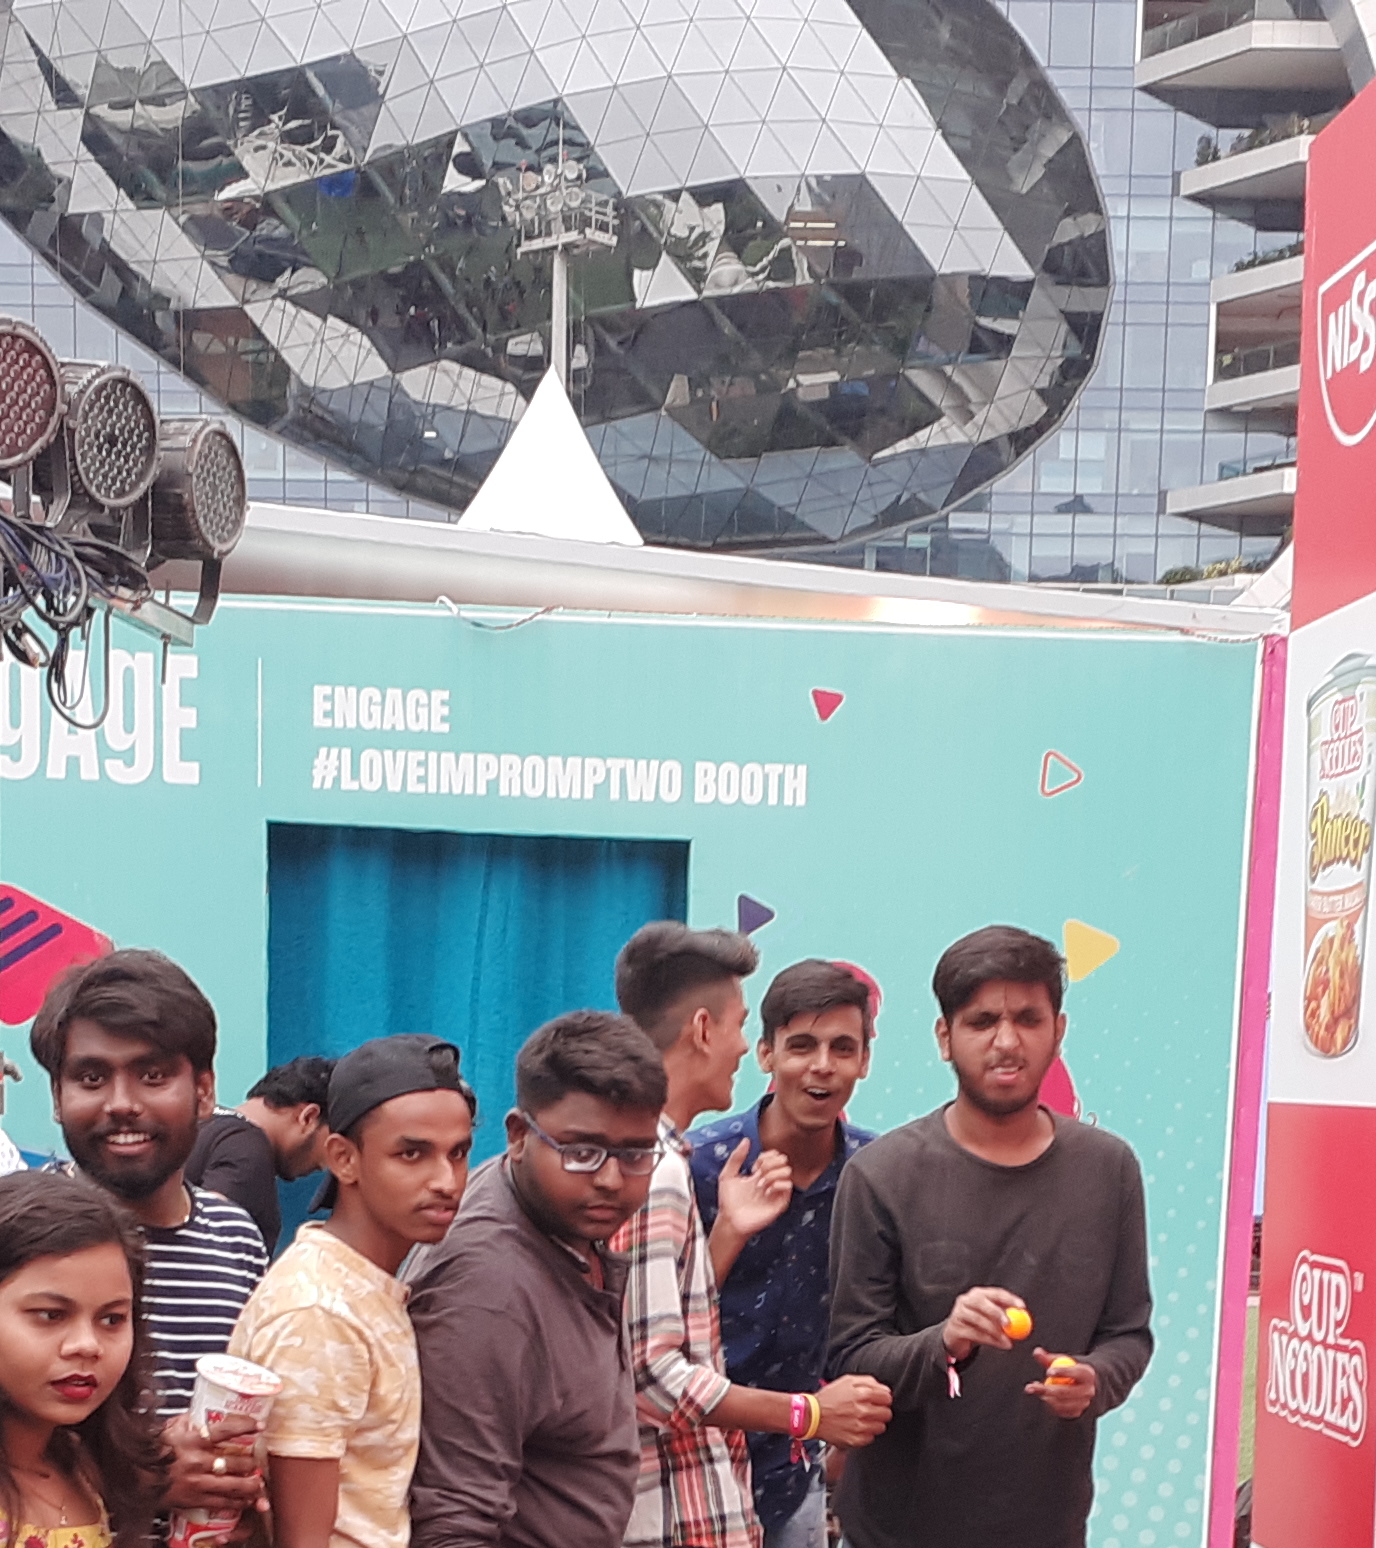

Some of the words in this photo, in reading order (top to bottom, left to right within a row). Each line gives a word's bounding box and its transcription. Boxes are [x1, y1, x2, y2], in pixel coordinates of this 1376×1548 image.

[312, 684, 451, 733] ENGAGE
[1332, 696, 1357, 737] CUP
[311, 746, 684, 805] #LOVEIMPROMPTWO
[693, 761, 809, 808] BOOTH
[1310, 788, 1372, 883] Paneer
[1294, 1262, 1348, 1345] CUP
[1269, 1331, 1364, 1435] NOODLES
